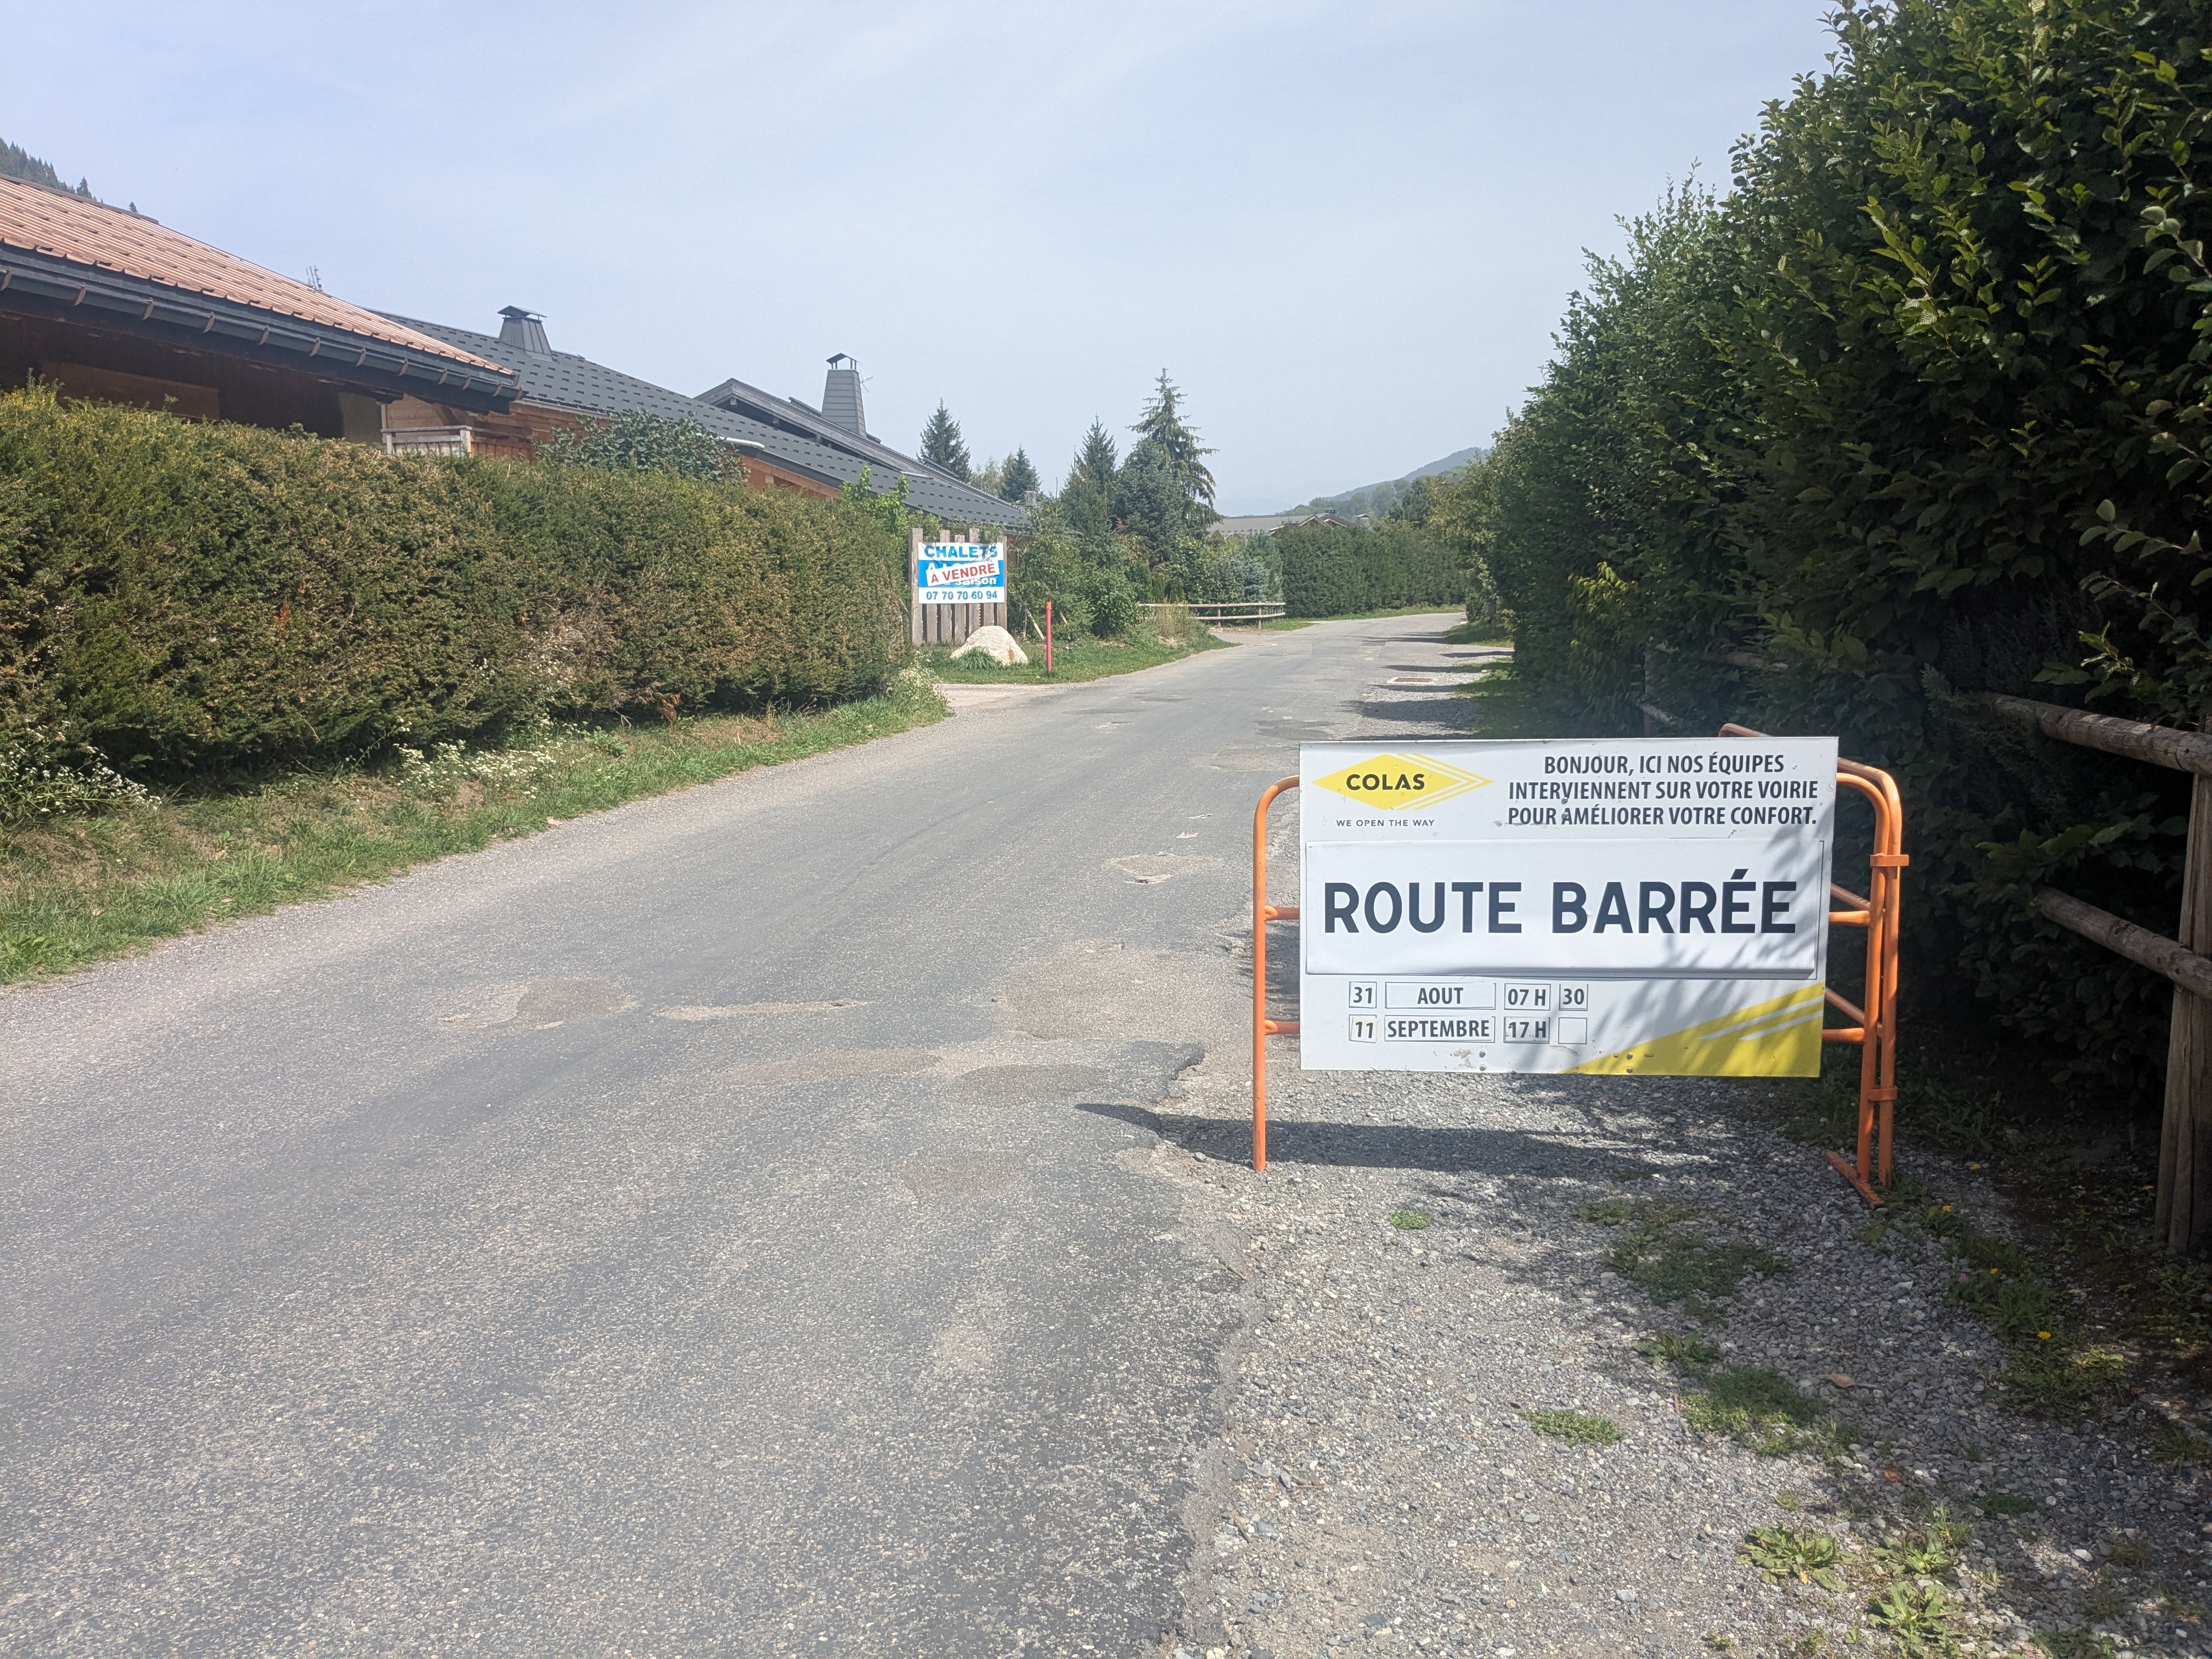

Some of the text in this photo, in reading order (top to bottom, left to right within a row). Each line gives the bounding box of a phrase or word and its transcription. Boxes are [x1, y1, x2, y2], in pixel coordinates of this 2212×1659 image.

[924, 545, 997, 557] CHALETS
[942, 563, 996, 581] VENDRE
[926, 590, 997, 600] 07 70 70 60 94
[1544, 752, 1784, 776] BONJOUR, ICI NOS ÉQUIPES
[1346, 774, 1425, 791] COLAS
[1509, 781, 1818, 800] INTERVIENNENT SUR VOTRE VOIRIE
[1508, 804, 1817, 825] POUR AMÉLIORER VOTRE CONFORT.
[1324, 868, 1797, 934] ROUTE BARRÉE
[1352, 986, 1584, 1006] 31 AOUT 07 H 30
[1355, 1020, 1546, 1039] 11 SEPTEMBRE 17 H
